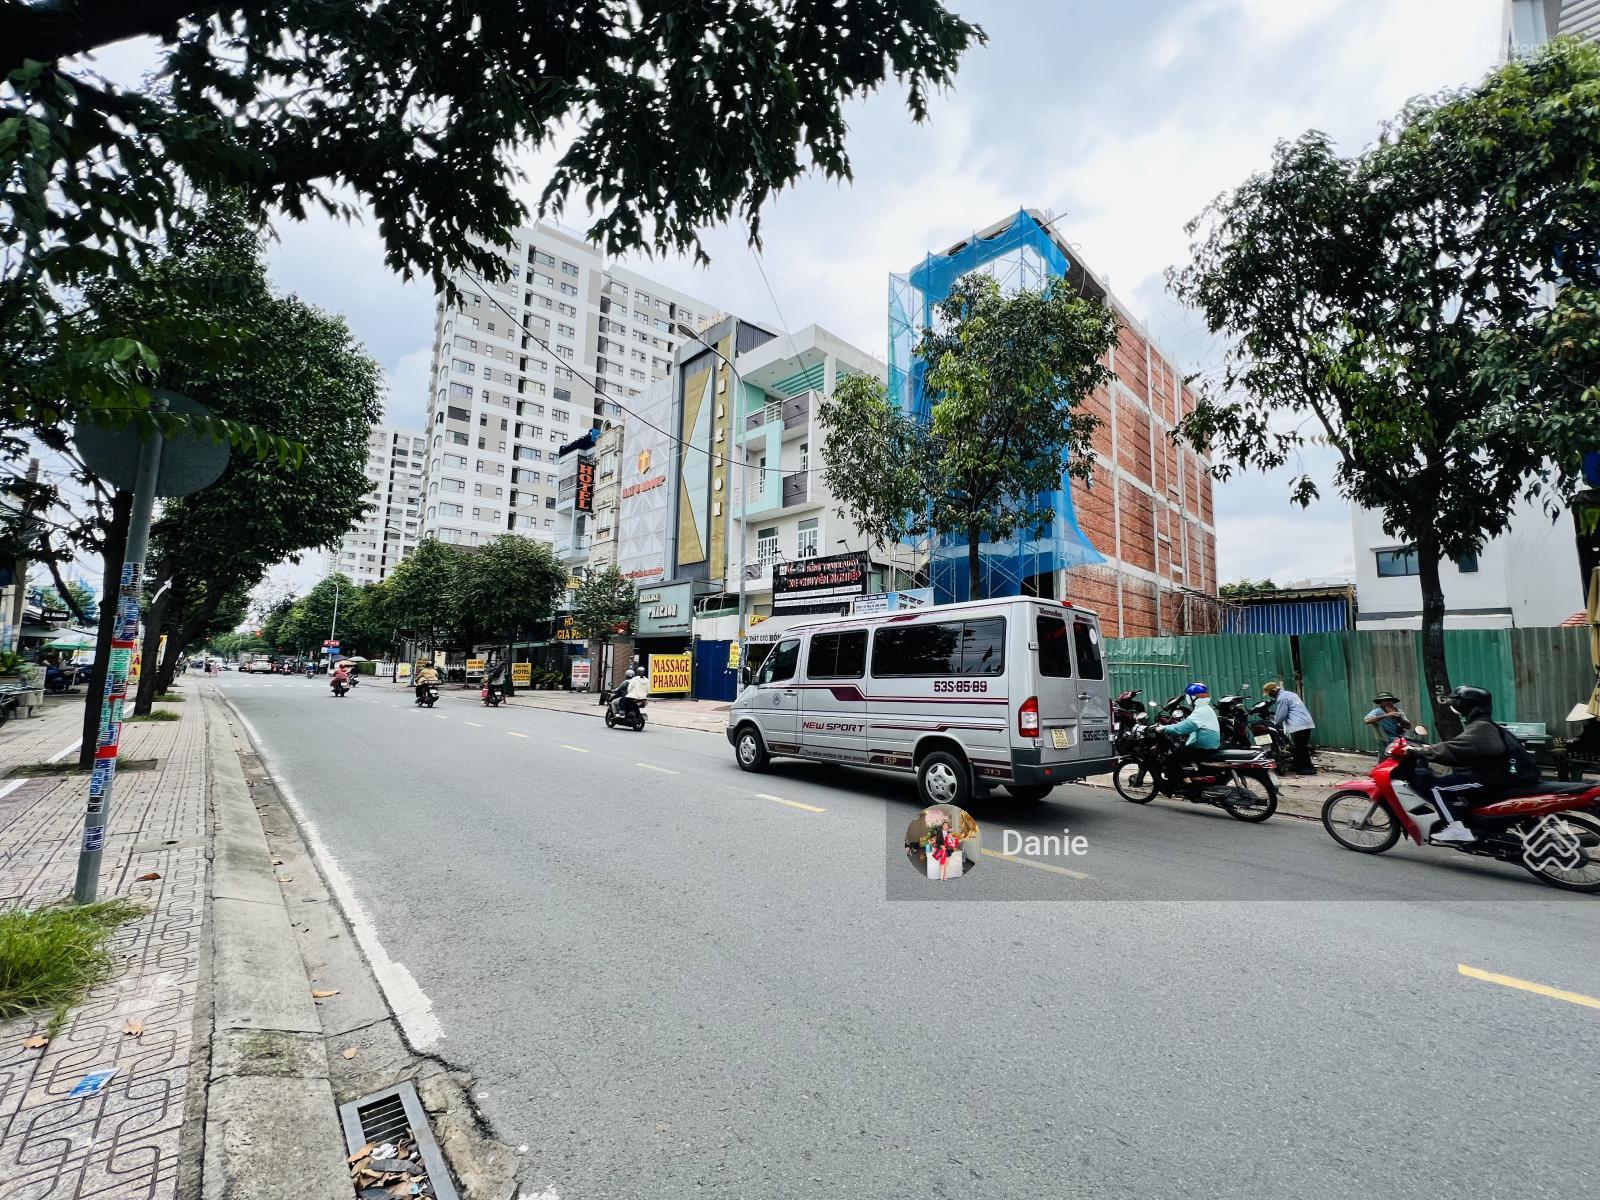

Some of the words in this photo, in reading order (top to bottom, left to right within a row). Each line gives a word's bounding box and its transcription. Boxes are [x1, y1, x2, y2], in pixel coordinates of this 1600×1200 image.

[578, 463, 593, 509] HOTEL
[648, 604, 677, 618] PHARAON
[653, 659, 690, 673] MASSAGE
[653, 674, 689, 688] PHARAON
[802, 720, 825, 730] NEW
[826, 723, 866, 733] SPORT
